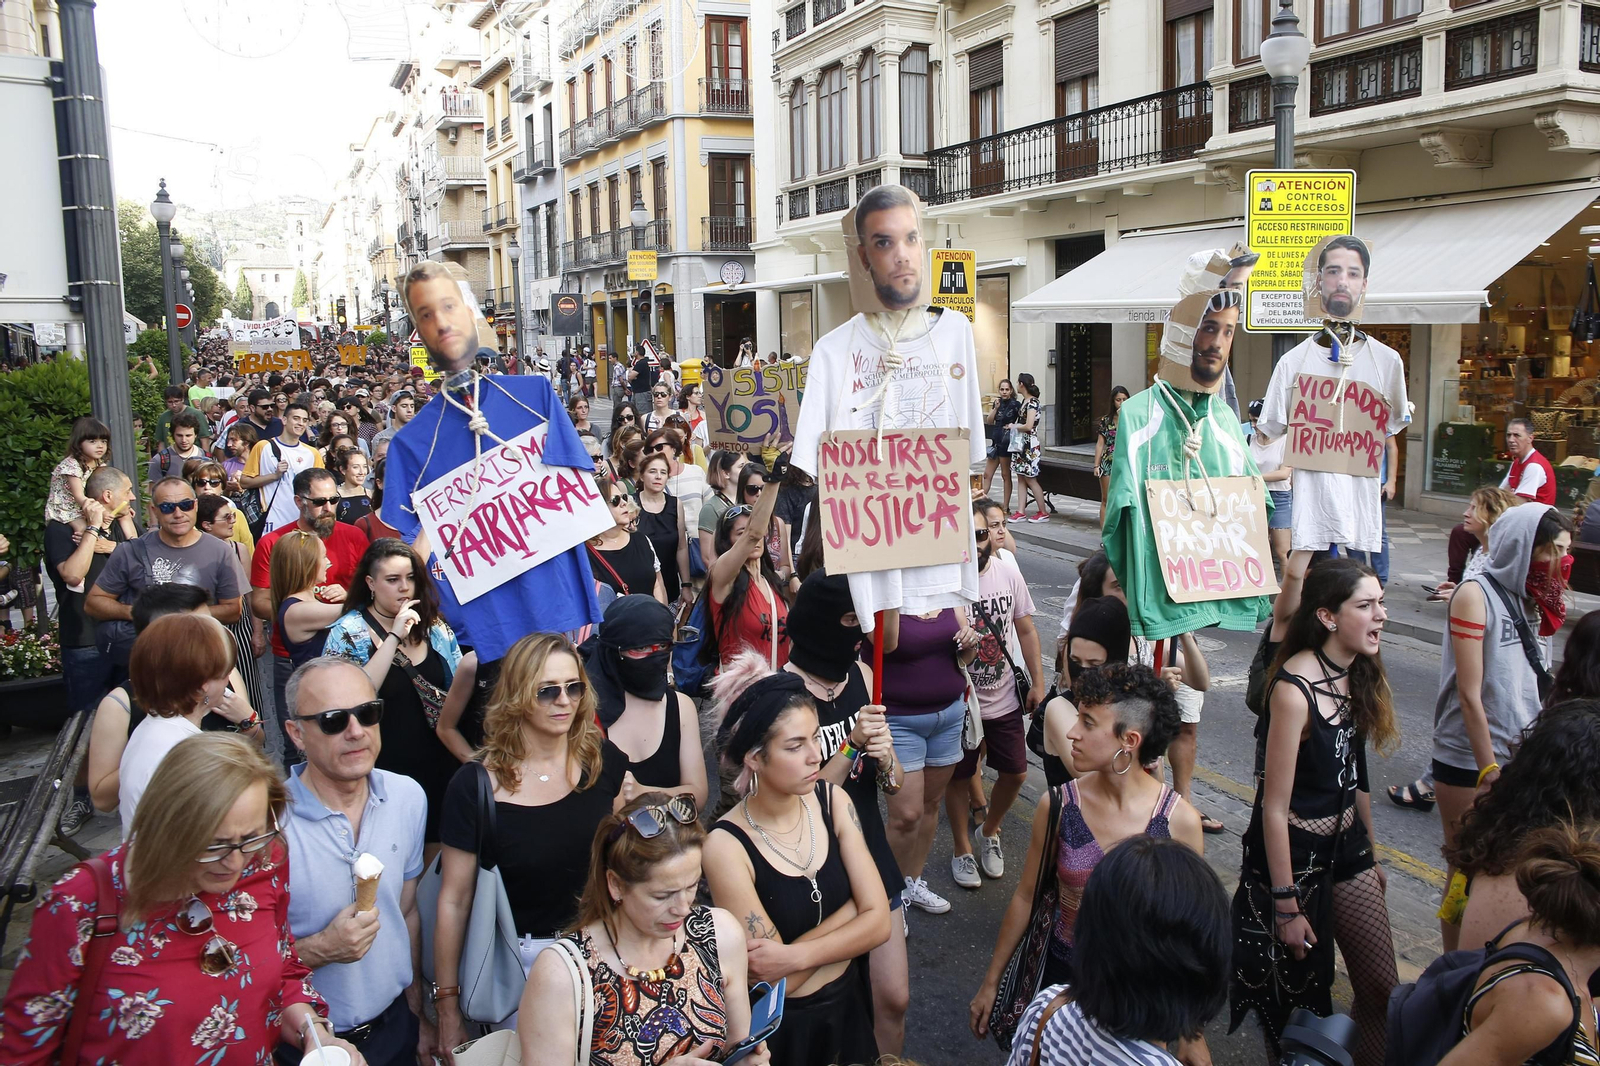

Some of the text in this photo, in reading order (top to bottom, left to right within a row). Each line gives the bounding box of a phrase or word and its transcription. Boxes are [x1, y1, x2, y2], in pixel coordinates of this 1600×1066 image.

[1277, 179, 1346, 190] ATENCIÓN
[1278, 203, 1345, 212] DE ACCESOS
[1287, 193, 1337, 201] CONTROL
[1257, 222, 1344, 231] ACCESO RESTRINGIDO
[1256, 235, 1280, 244] CALLE
[1280, 235, 1303, 244] REYES
[935, 250, 972, 261] ATENCIÓN
[1251, 279, 1276, 287] VÍSPERA
[1279, 279, 1287, 287] DE
[932, 295, 975, 305] OBSTÁCULOS
[1128, 310, 1155, 321] tienda
[337, 344, 367, 366] YA!
[1294, 400, 1334, 428] AL
[1298, 375, 1390, 434] VIOLADOR
[710, 441, 750, 452] #METOO
[822, 433, 953, 473] NOSOTRAS
[1289, 423, 1384, 473] TRITURADOR
[825, 471, 961, 496] HAREMOS
[437, 467, 601, 579] PATRIARCAL
[823, 491, 961, 550] JUSTICIA
[1157, 519, 1259, 559] PASAR
[1165, 555, 1266, 594] MIEDO
[972, 595, 1012, 618] BEACH
